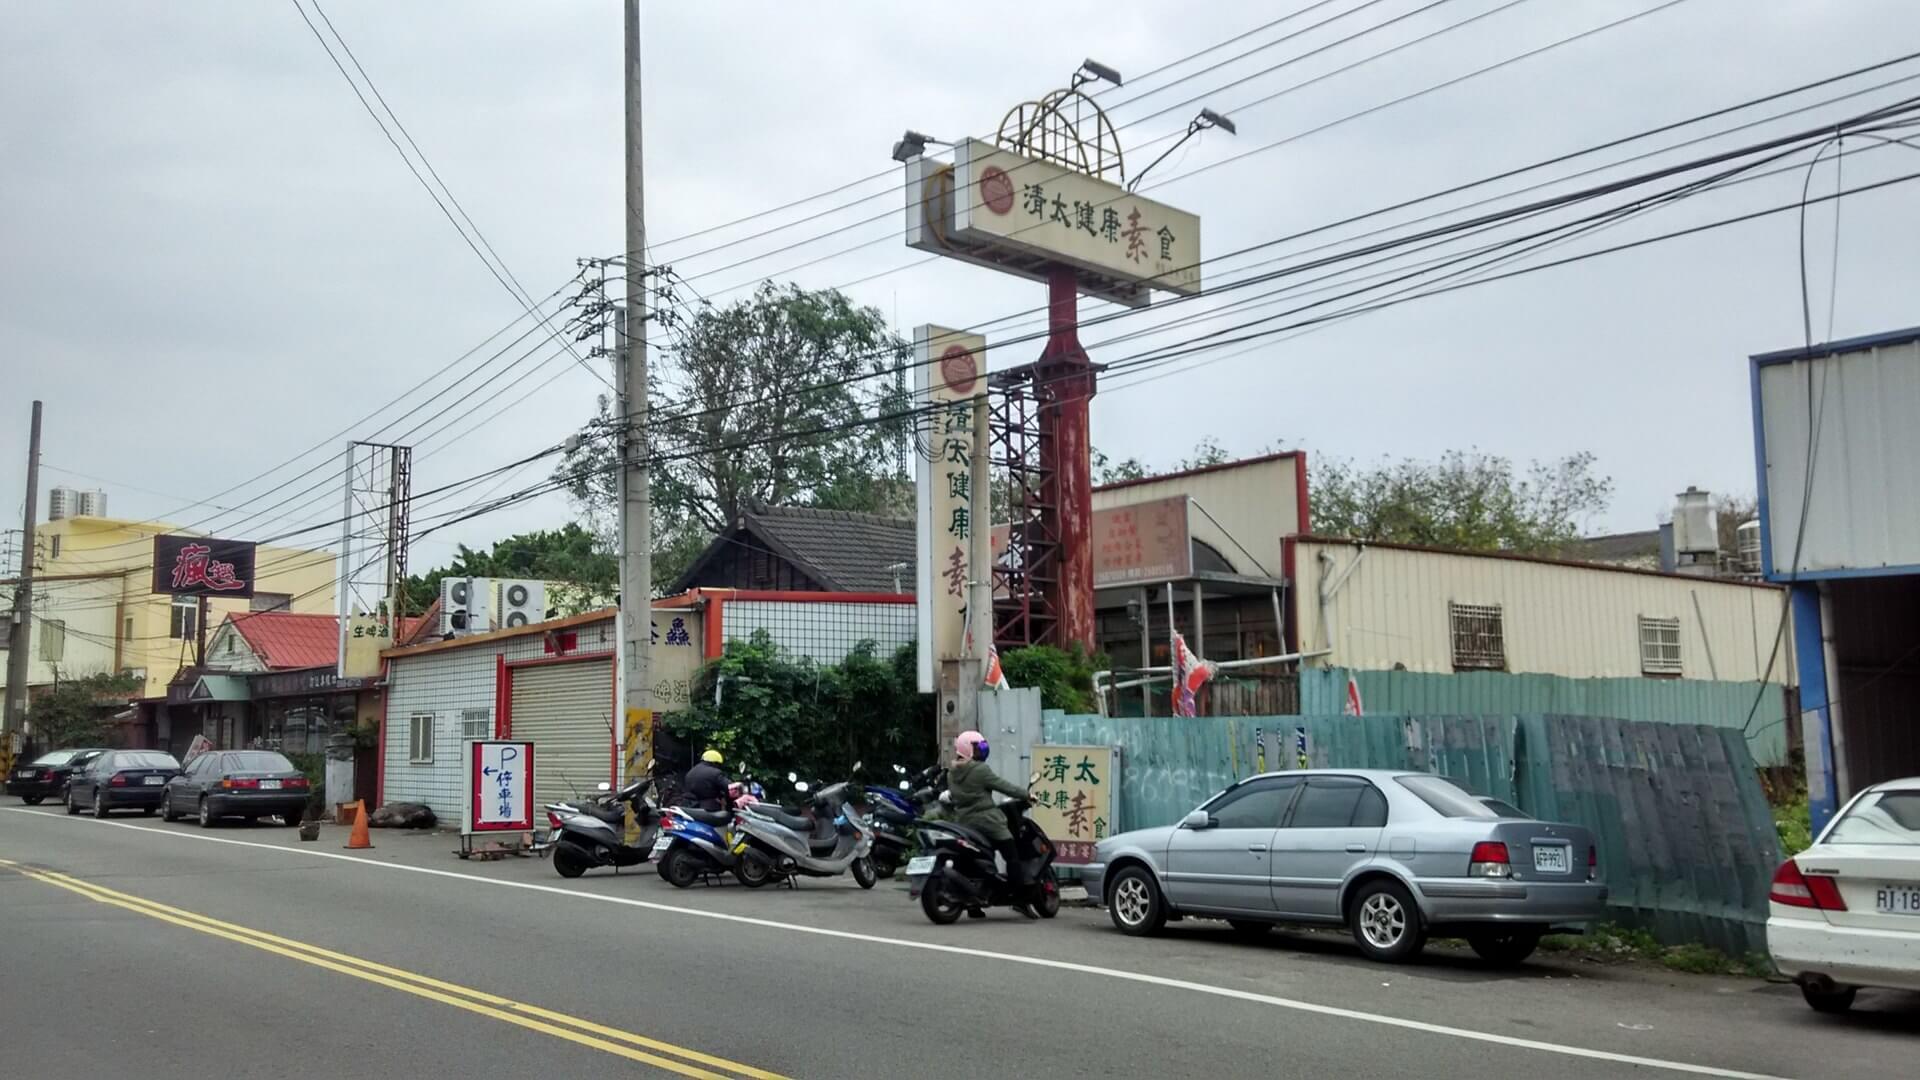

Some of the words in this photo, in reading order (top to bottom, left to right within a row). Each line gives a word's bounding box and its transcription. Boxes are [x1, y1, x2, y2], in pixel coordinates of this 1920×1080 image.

[1023, 183, 1176, 264] 清太健康素食
[500, 746, 518, 770] P
[1042, 754, 1100, 785] 清太
[495, 770, 513, 819] 停車場
